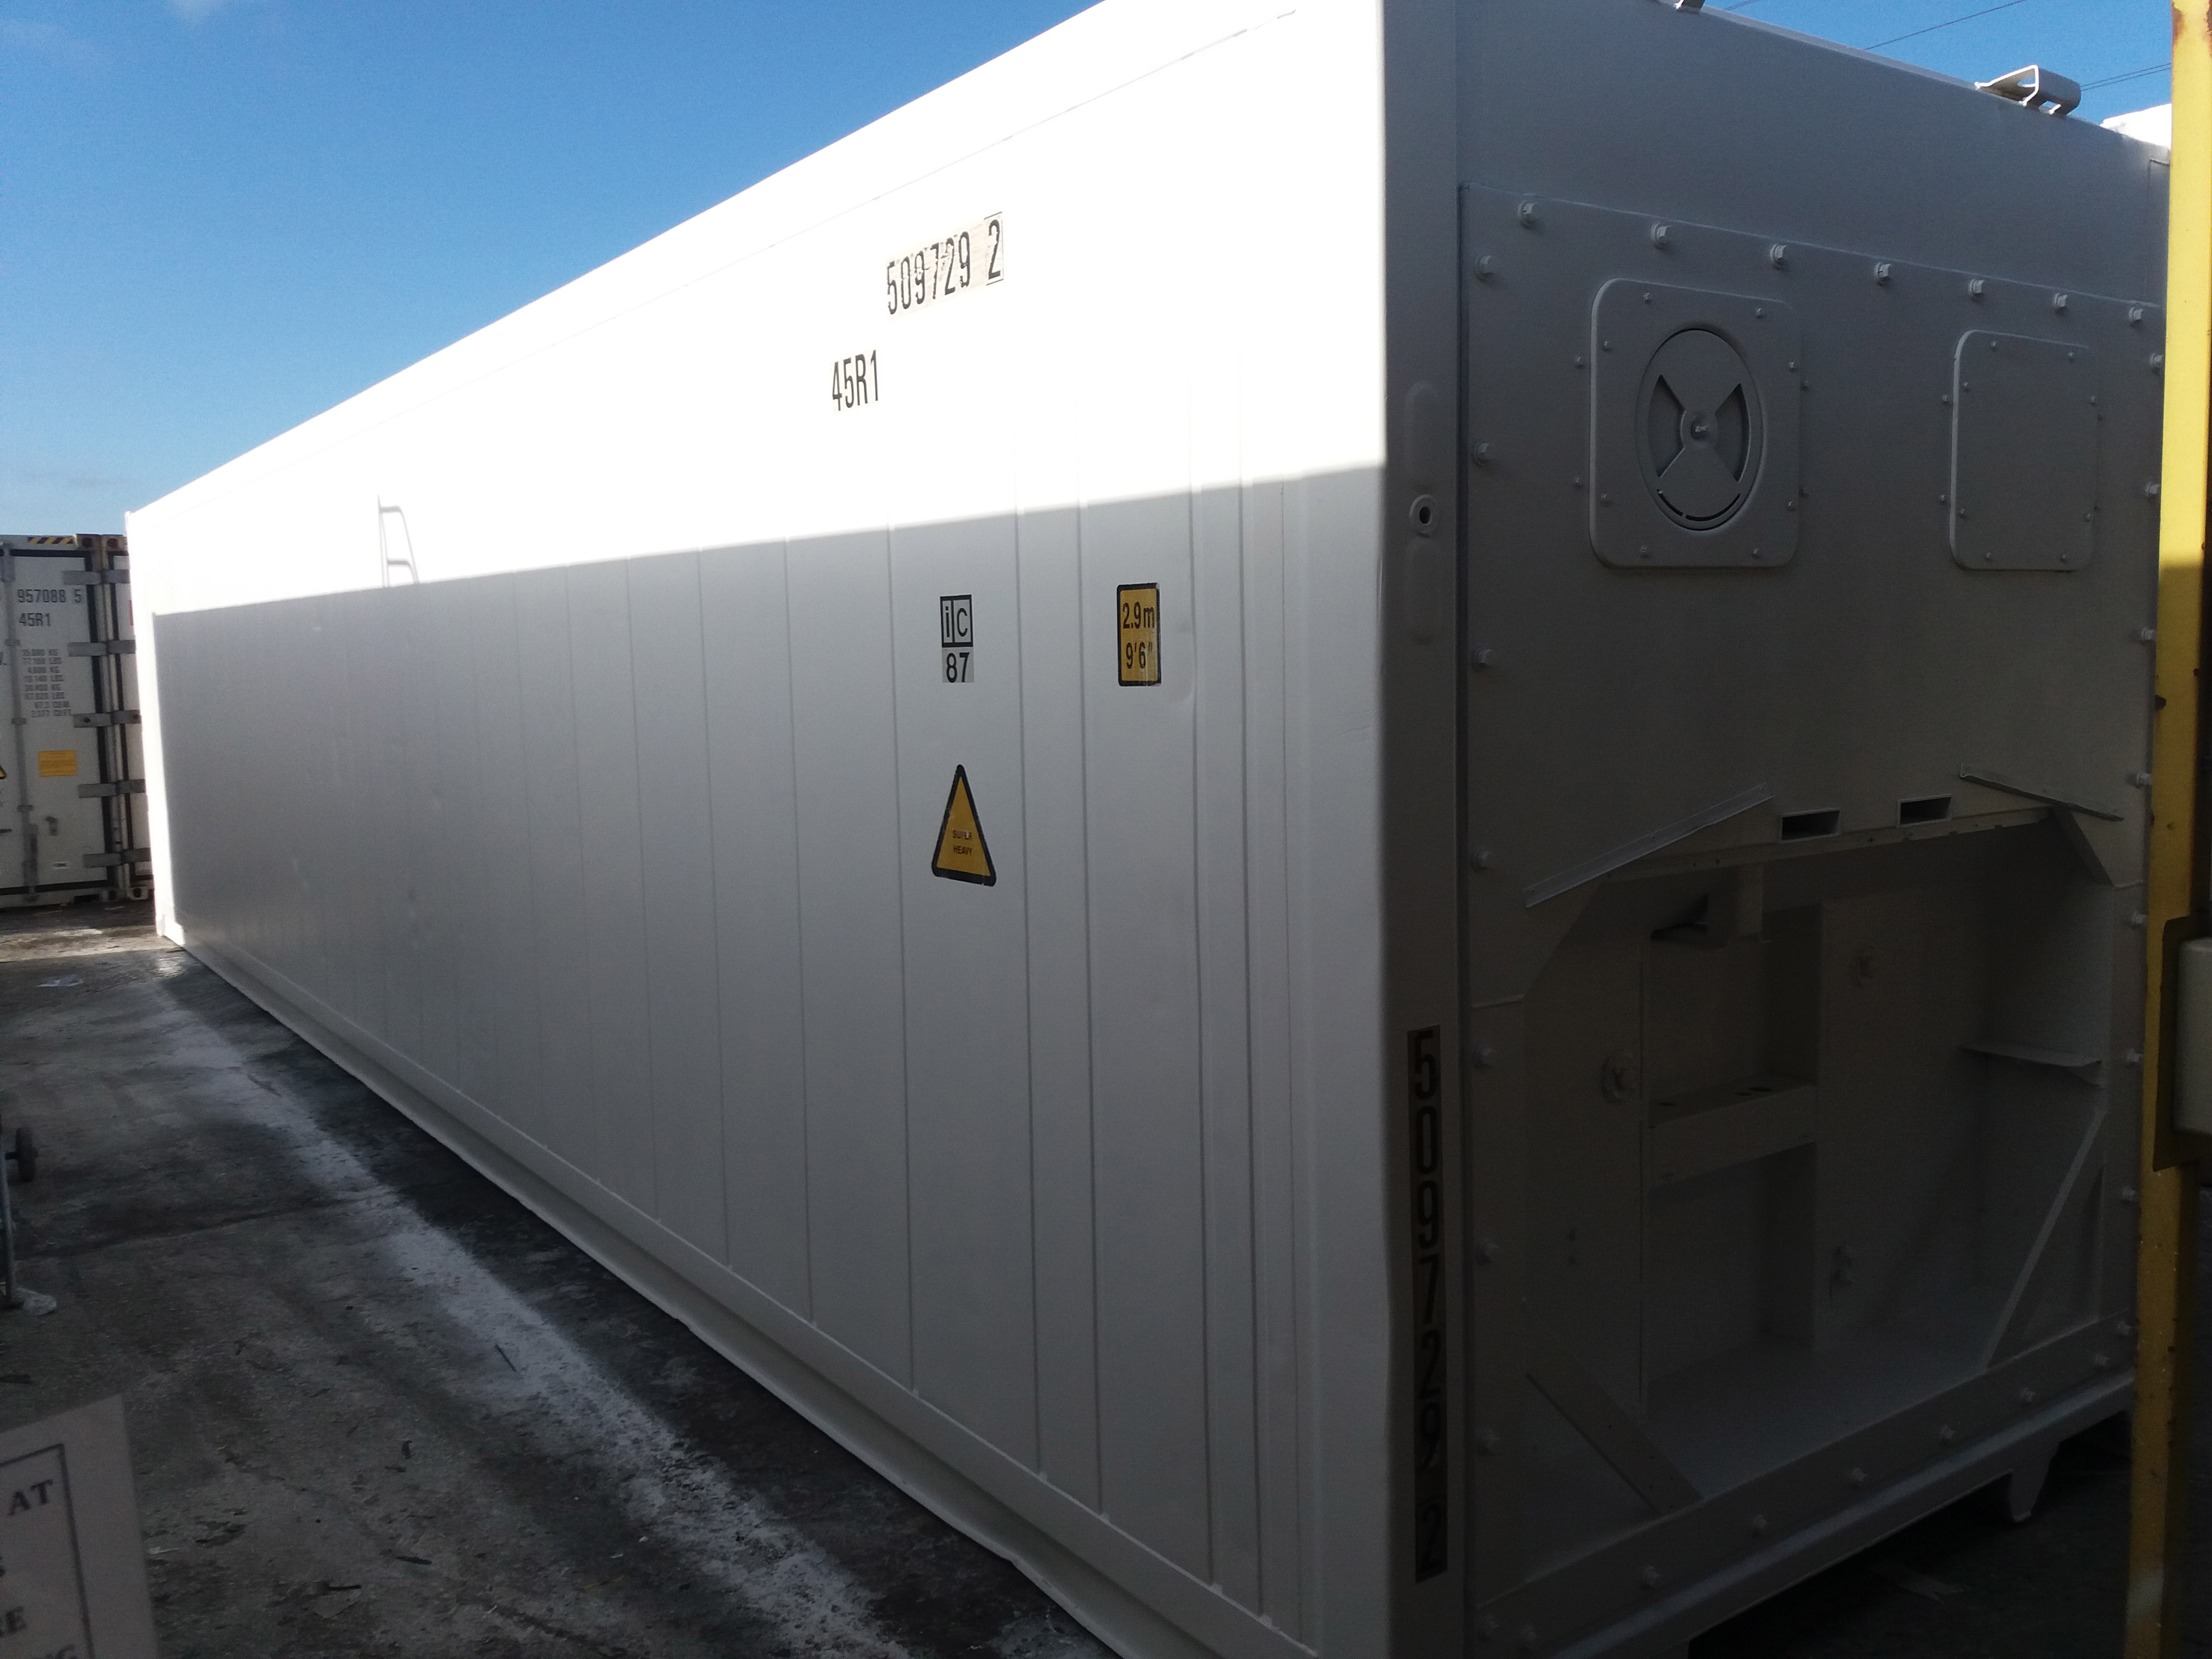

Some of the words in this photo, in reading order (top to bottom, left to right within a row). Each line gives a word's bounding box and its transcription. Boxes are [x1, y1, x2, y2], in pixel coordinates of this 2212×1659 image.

[887, 231, 971, 315] 509729
[988, 219, 1001, 280] 2
[832, 349, 878, 411] 45R1
[17, 589, 65, 603] 957088
[74, 589, 82, 603] 5
[19, 612, 51, 626] 45R1
[946, 652, 970, 683] 87
[953, 845, 973, 856] HEAVY
